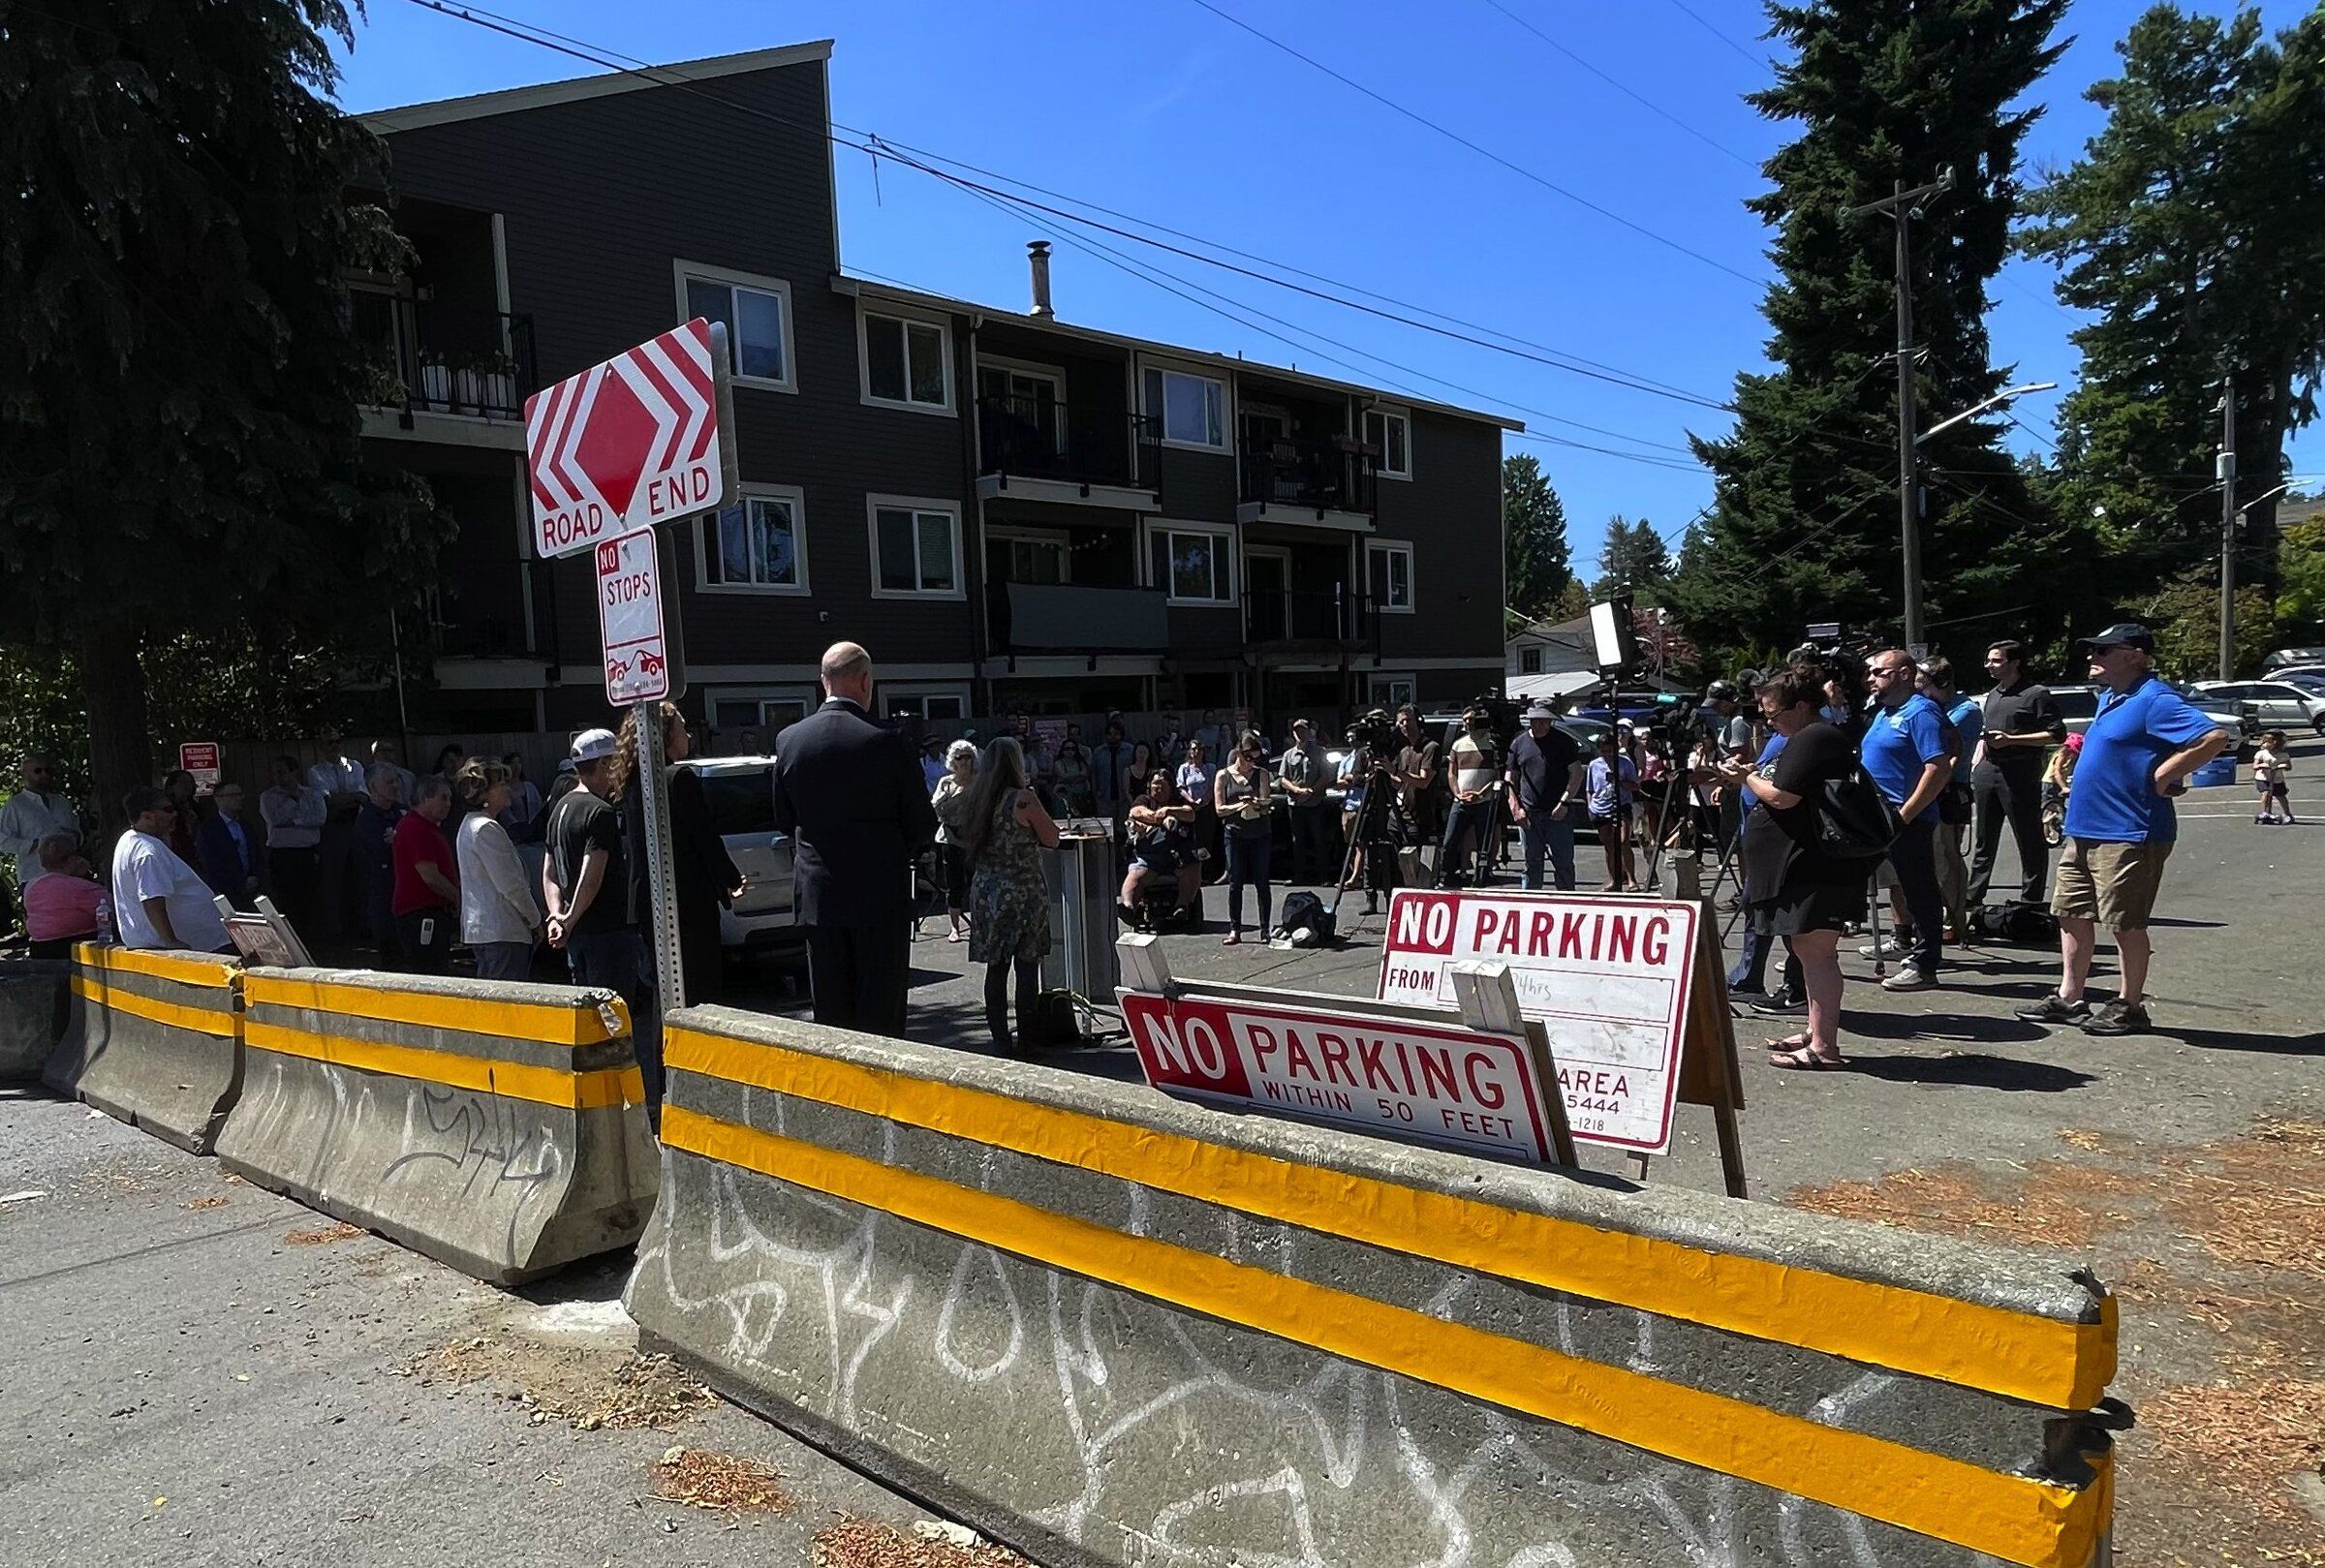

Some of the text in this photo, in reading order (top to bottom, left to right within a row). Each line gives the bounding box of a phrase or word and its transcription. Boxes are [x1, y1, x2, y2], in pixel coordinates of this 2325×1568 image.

[542, 466, 710, 550] ROAD END
[600, 546, 617, 571] NO
[607, 571, 651, 606] STOPS
[1396, 900, 1670, 966] NO PARKING
[1388, 968, 1436, 991] FROM
[1141, 1012, 1506, 1111] NO PARKING
[1557, 1068, 1629, 1098] AREA
[1262, 1080, 1513, 1140] WITHIN 50 FEET
[1566, 1094, 1620, 1116] 5444
